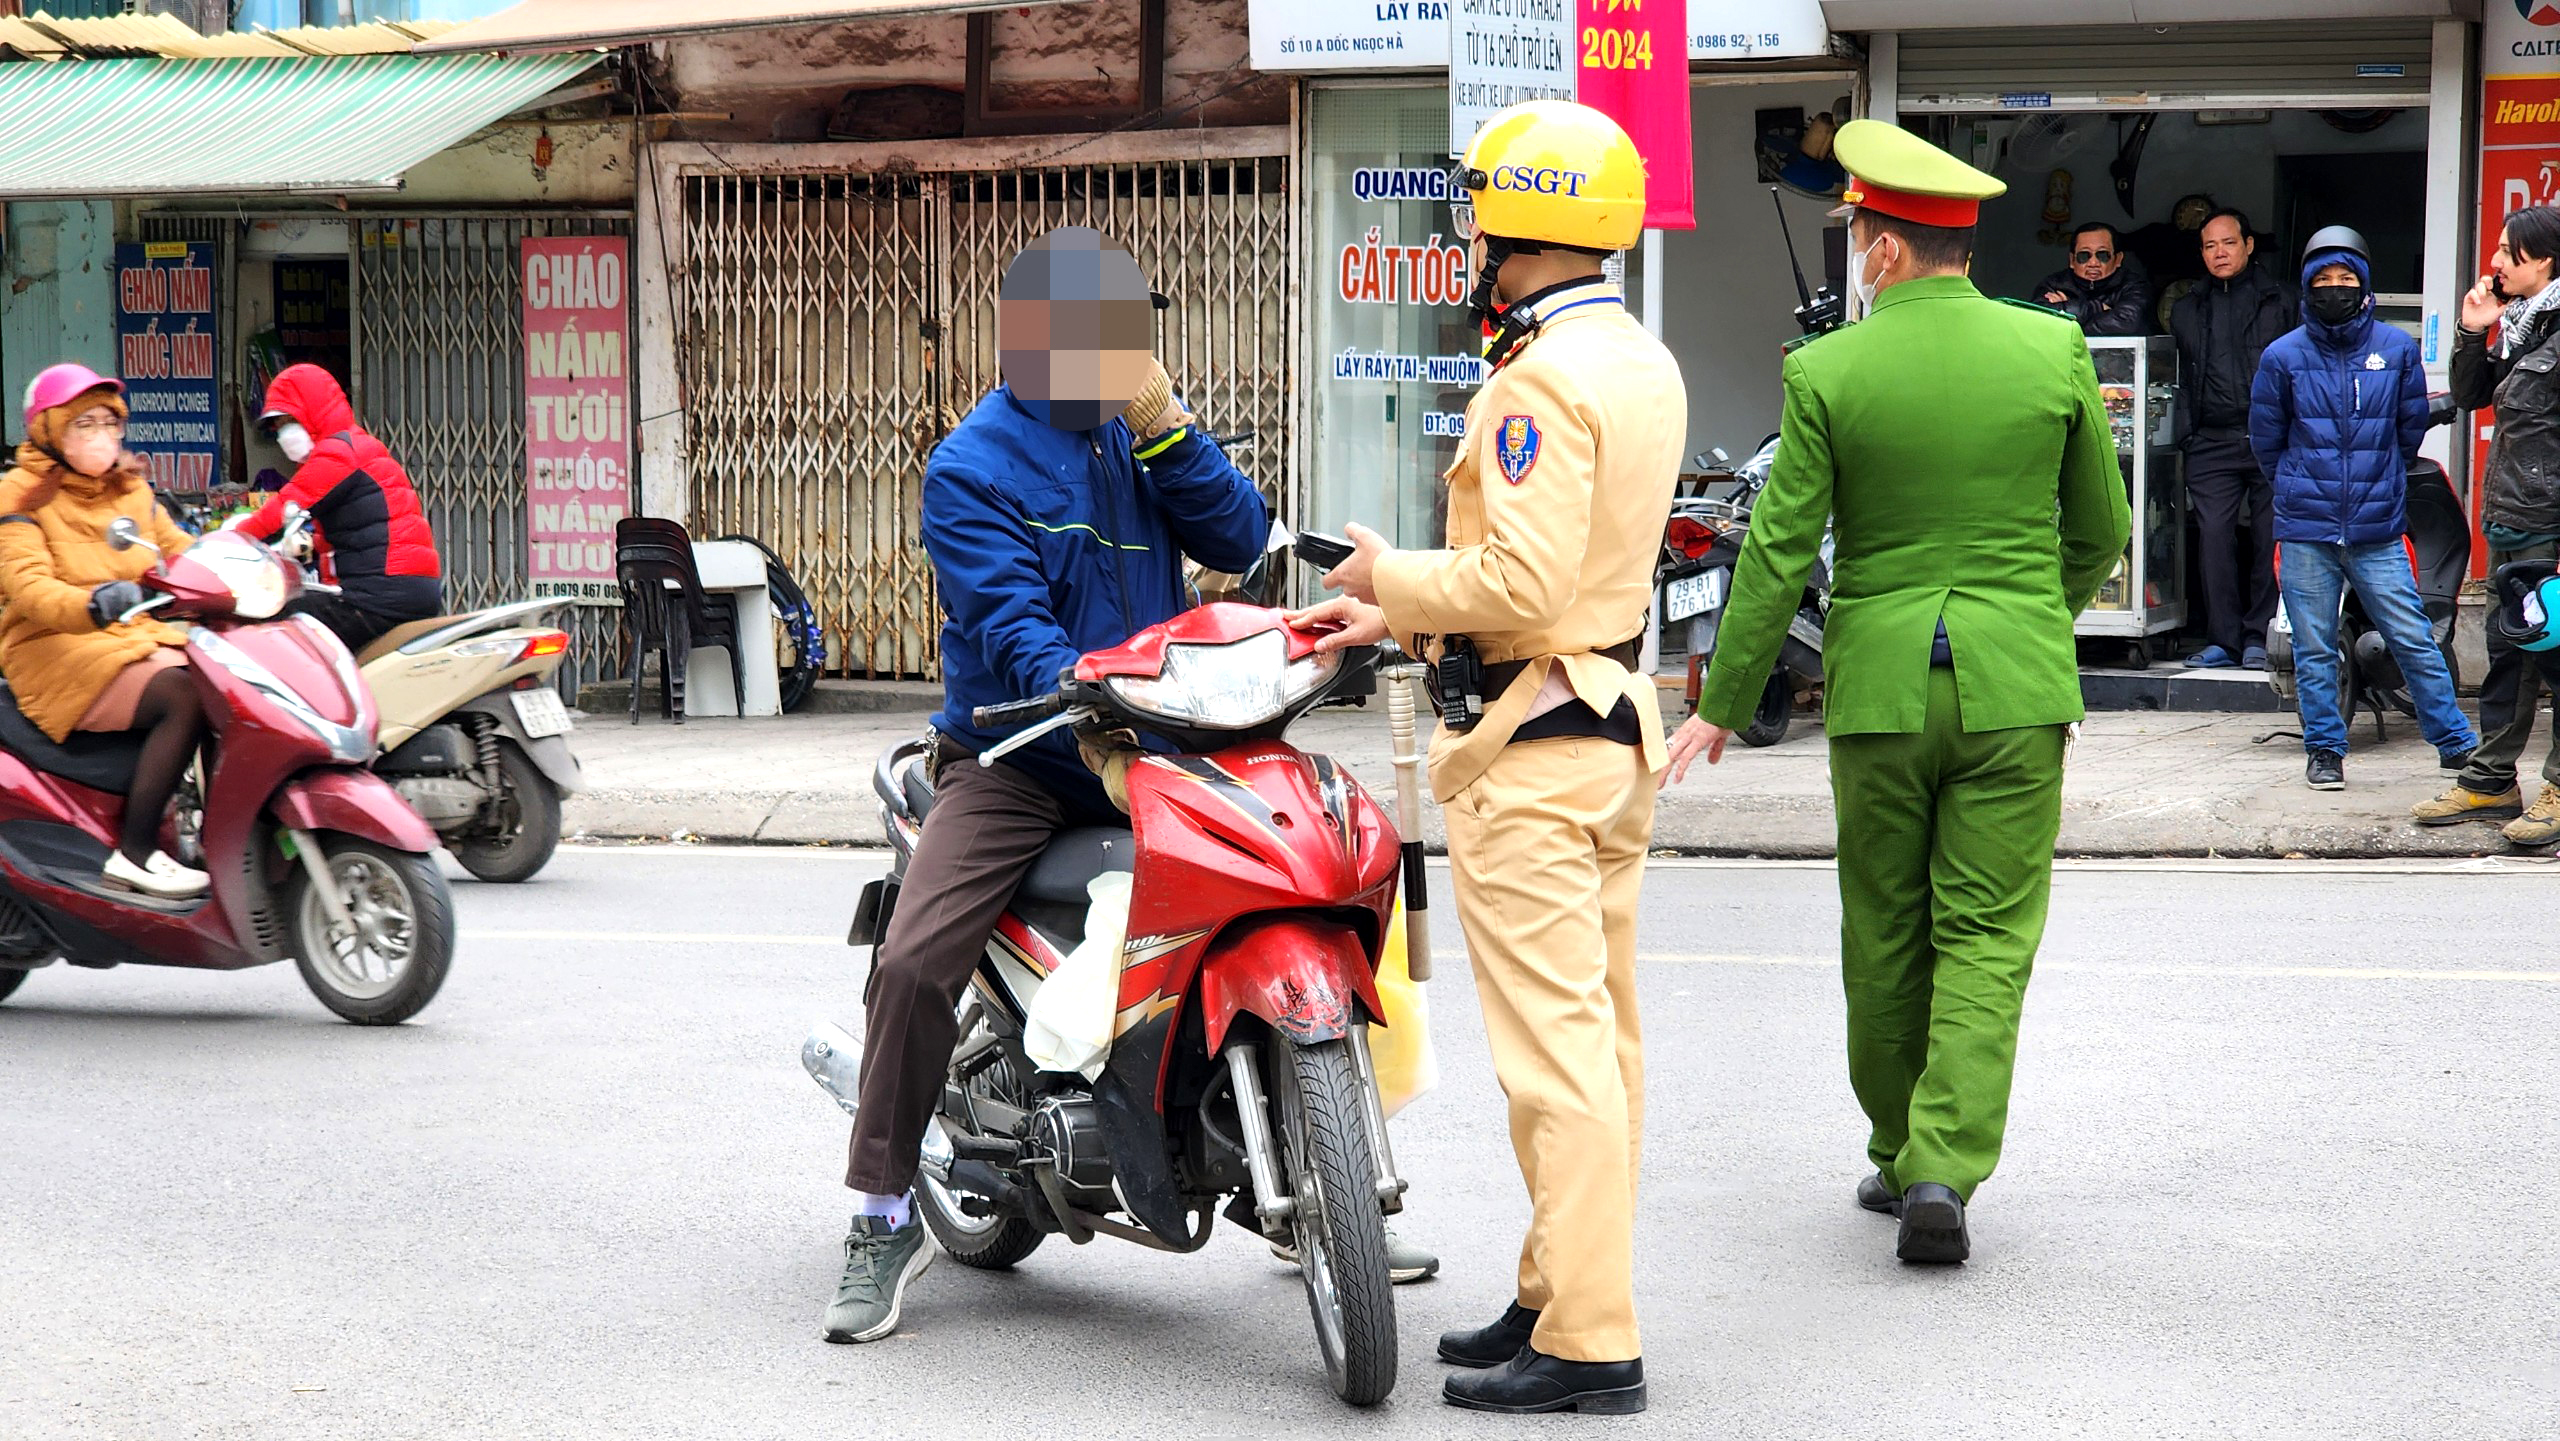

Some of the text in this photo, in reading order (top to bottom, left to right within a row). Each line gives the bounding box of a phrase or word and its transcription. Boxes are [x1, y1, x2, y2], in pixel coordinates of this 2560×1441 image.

[1281, 31, 1404, 54] SỐ 10 A DỐC NGỌC HÀ
[1466, 22, 1562, 72] TỪ 16 CHỖ TRỞ LÊN
[1583, 26, 1653, 70] 2024
[1697, 34, 1726, 48] 0986
[1758, 33, 1780, 47] 156
[1489, 84, 1498, 108] XE
[2494, 98, 2560, 125] Havol
[1353, 169, 1446, 200] QUANG
[1493, 166, 1586, 197] CSGT
[527, 245, 620, 310] CHÁO
[1342, 227, 1464, 303] CẮT TÓC
[121, 258, 167, 314] CHÁO
[169, 251, 211, 314] NẤM
[123, 317, 213, 379] RUỐC NẤM
[529, 315, 621, 378] NẤM
[1336, 349, 1360, 378] LẤY
[1365, 350, 1393, 378] RÁY
[1396, 358, 1417, 379] TAI
[1429, 353, 1480, 387] NHUỘM
[130, 392, 210, 412] MUSHROOM CONGEE
[528, 388, 622, 443] TƯƠI
[126, 422, 216, 442] MUSHROOM PEMMICAN
[1425, 414, 1465, 434] ĐT: 09
[534, 447, 626, 492] RUỐC:
[1500, 450, 1532, 462] CSGT
[535, 495, 623, 533] NẤM
[531, 539, 618, 572] TƯƠ
[553, 583, 579, 598] 0979
[582, 583, 600, 598] 467
[1675, 575, 1710, 599] 29-B1
[1672, 591, 1715, 617] 276.14
[1246, 753, 1299, 766] HONDA
